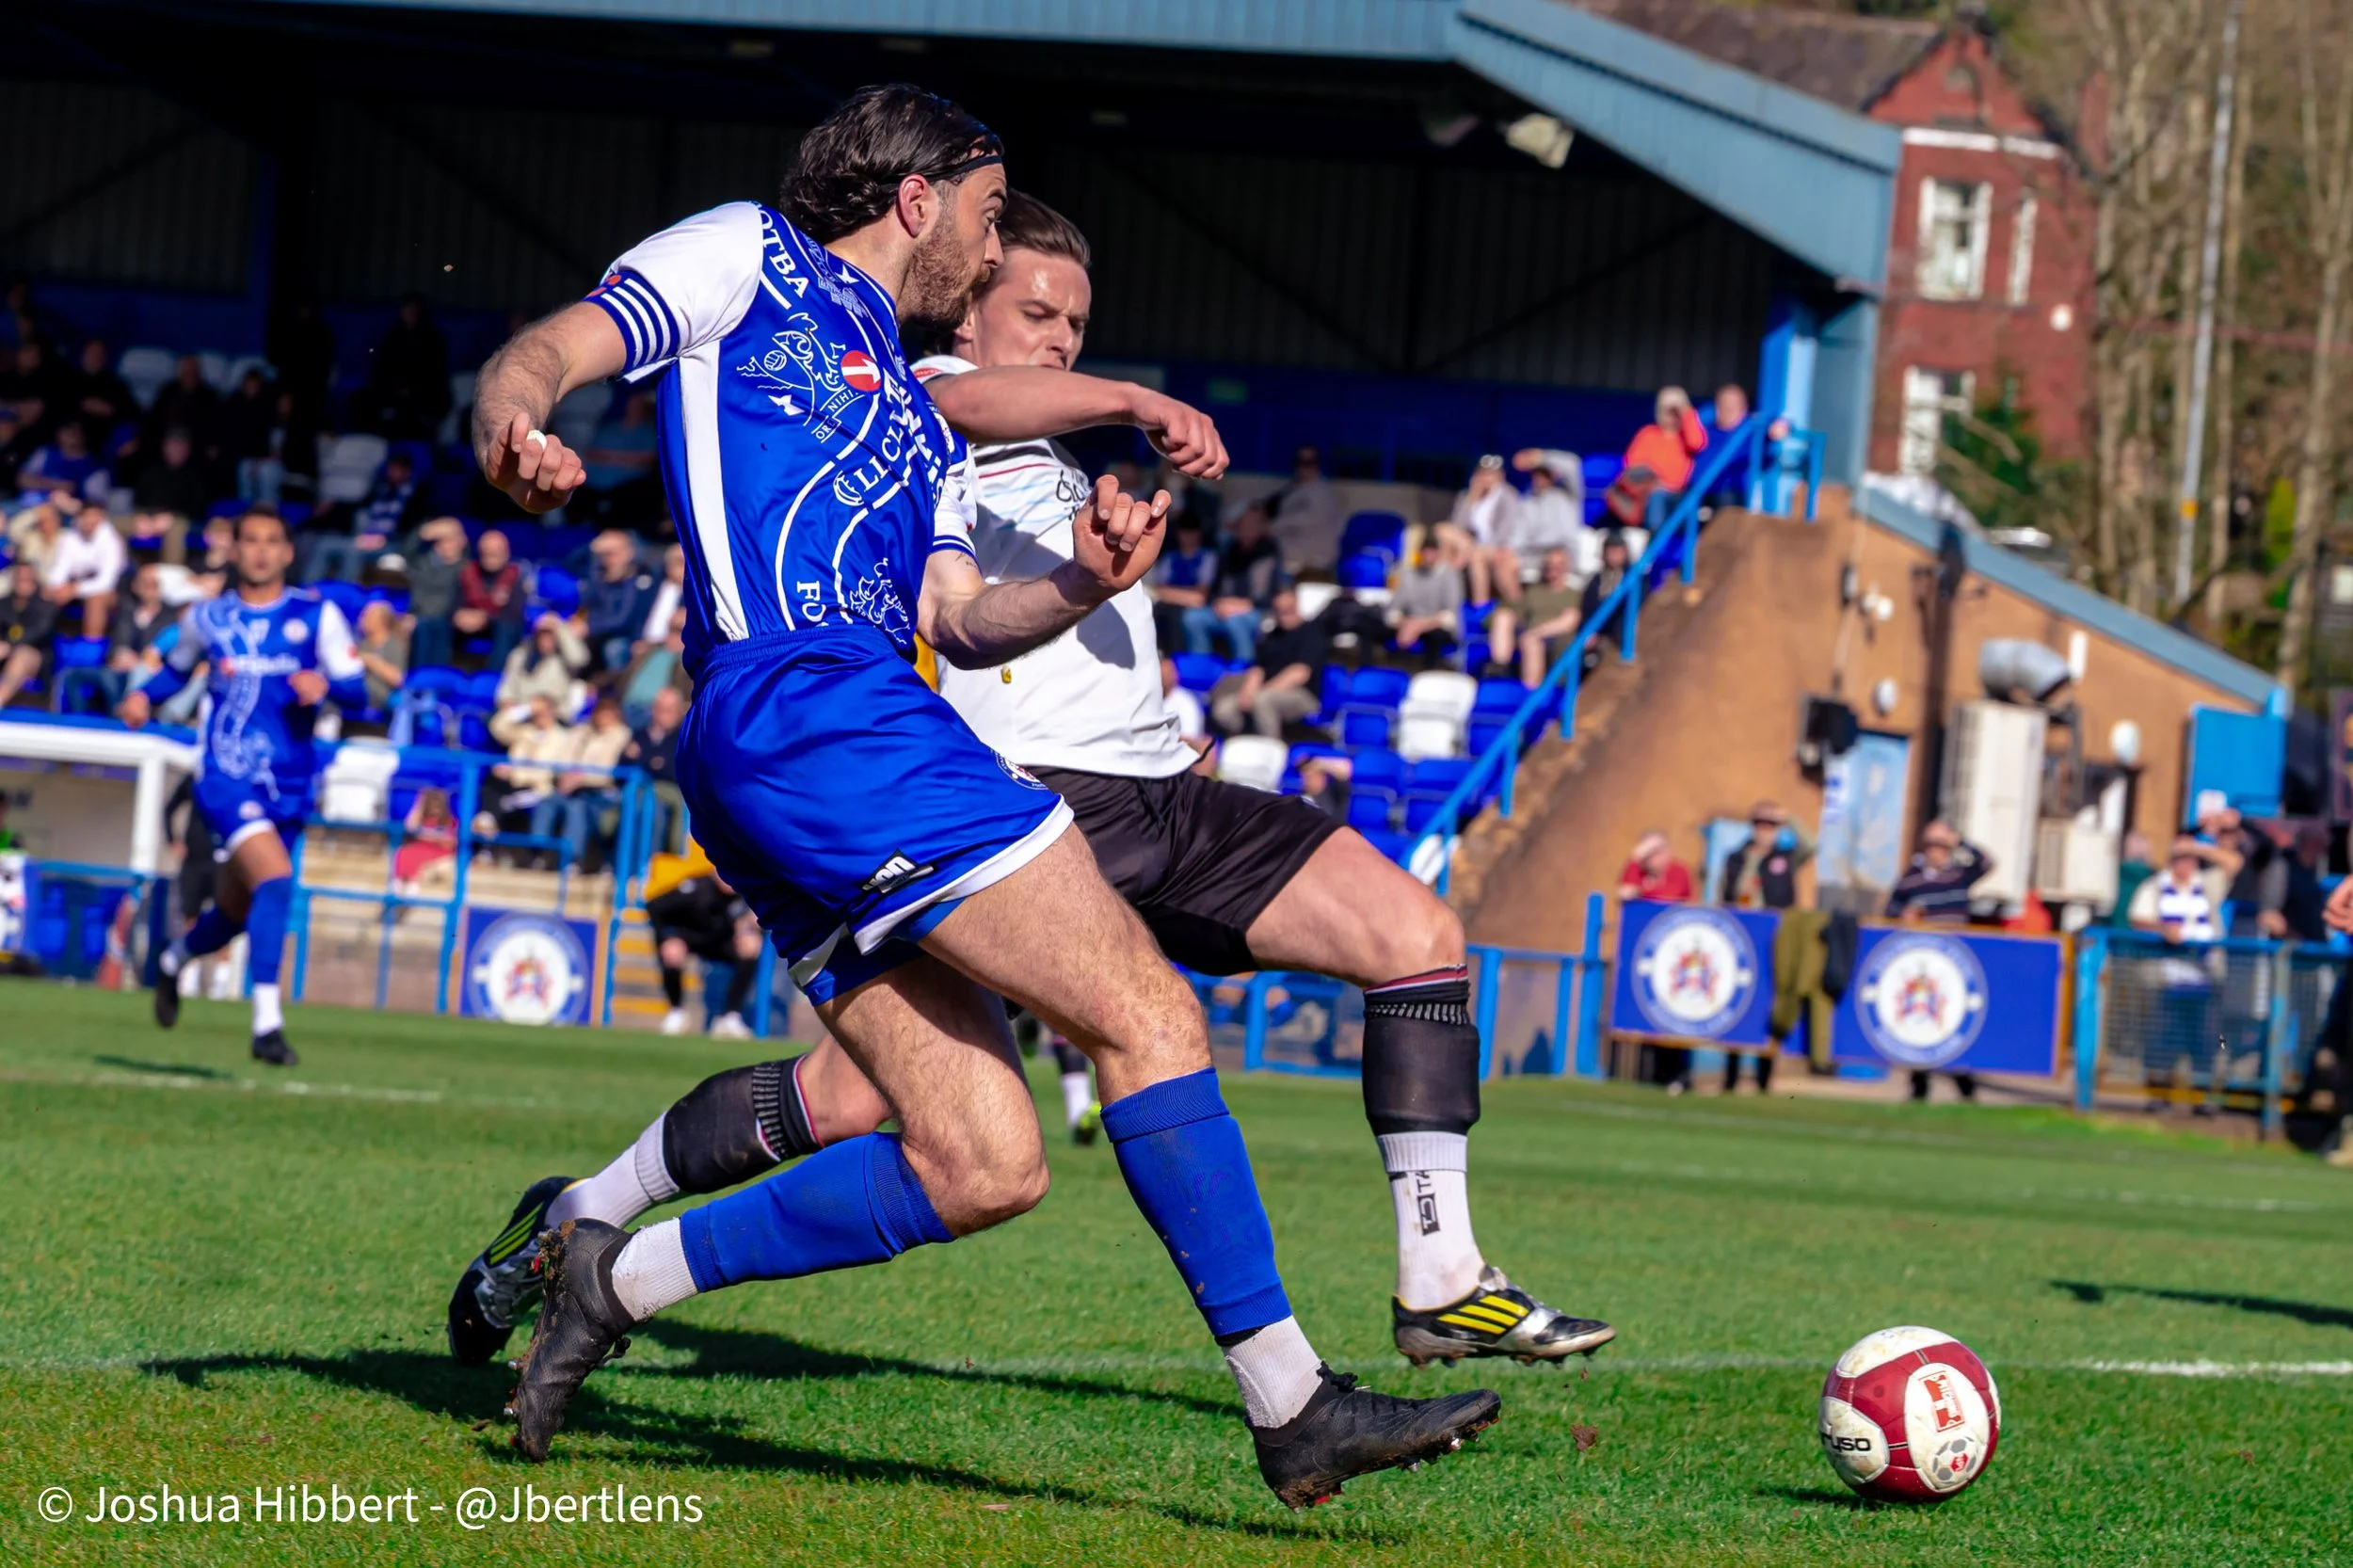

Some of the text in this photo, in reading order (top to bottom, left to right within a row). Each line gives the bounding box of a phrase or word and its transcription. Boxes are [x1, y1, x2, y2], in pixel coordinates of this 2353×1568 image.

[751, 201, 809, 299] OTBA
[827, 390, 857, 412] NIHI
[796, 580, 829, 627] FO
